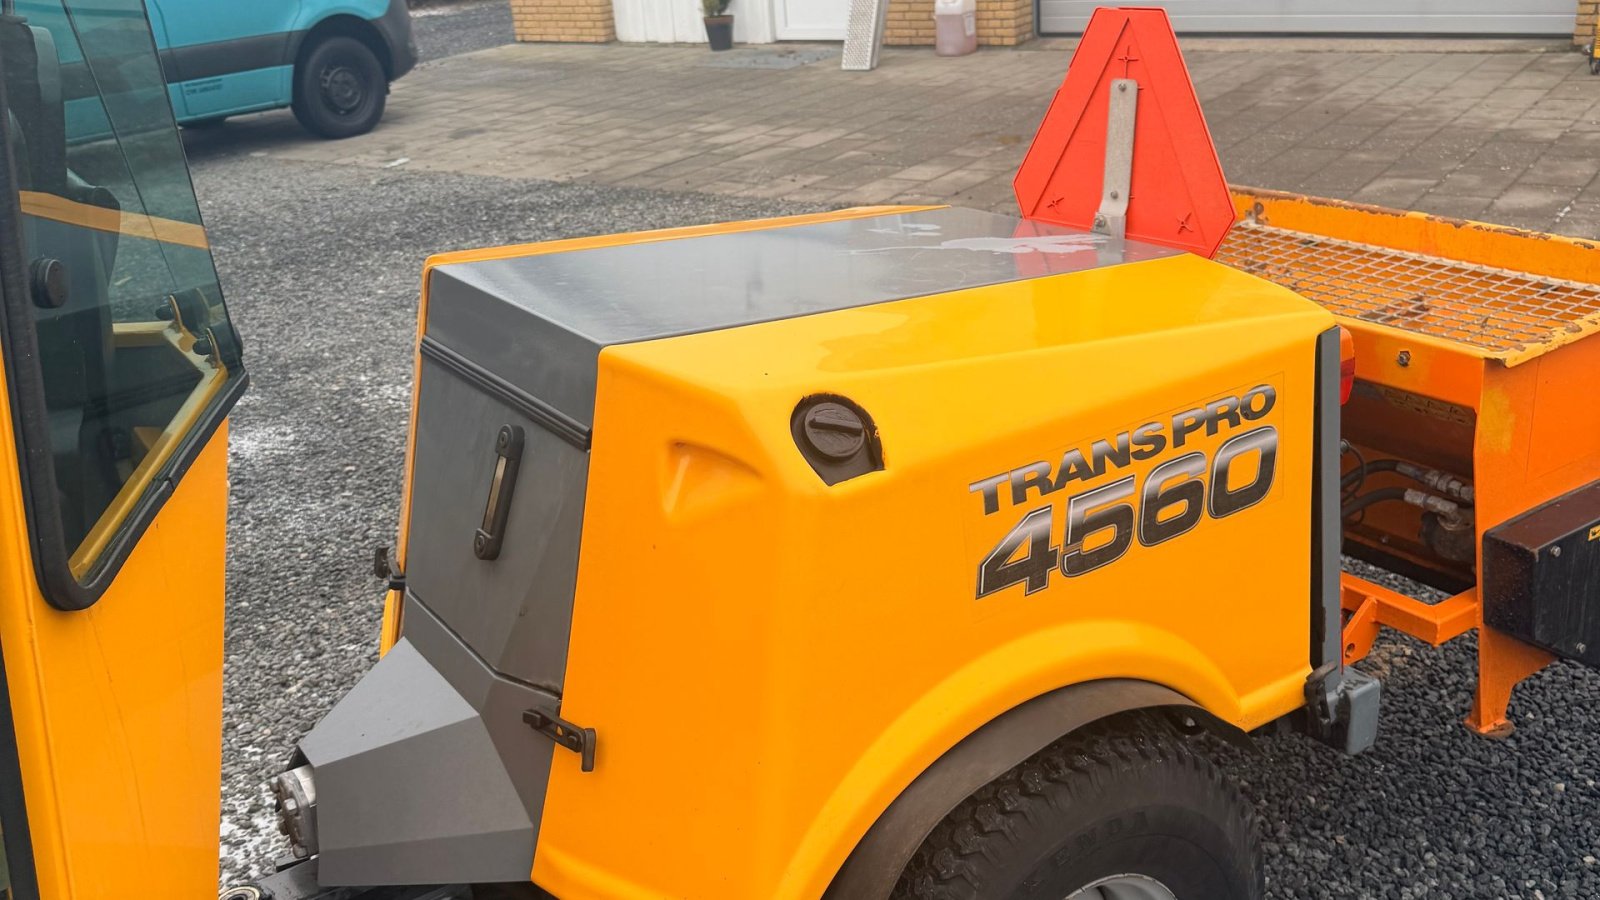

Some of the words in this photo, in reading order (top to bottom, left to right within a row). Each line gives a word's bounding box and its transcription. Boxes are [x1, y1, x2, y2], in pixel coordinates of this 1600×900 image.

[969, 421, 1167, 516] TRANS
[1172, 384, 1277, 448] PRO
[975, 425, 1278, 600] 4560
